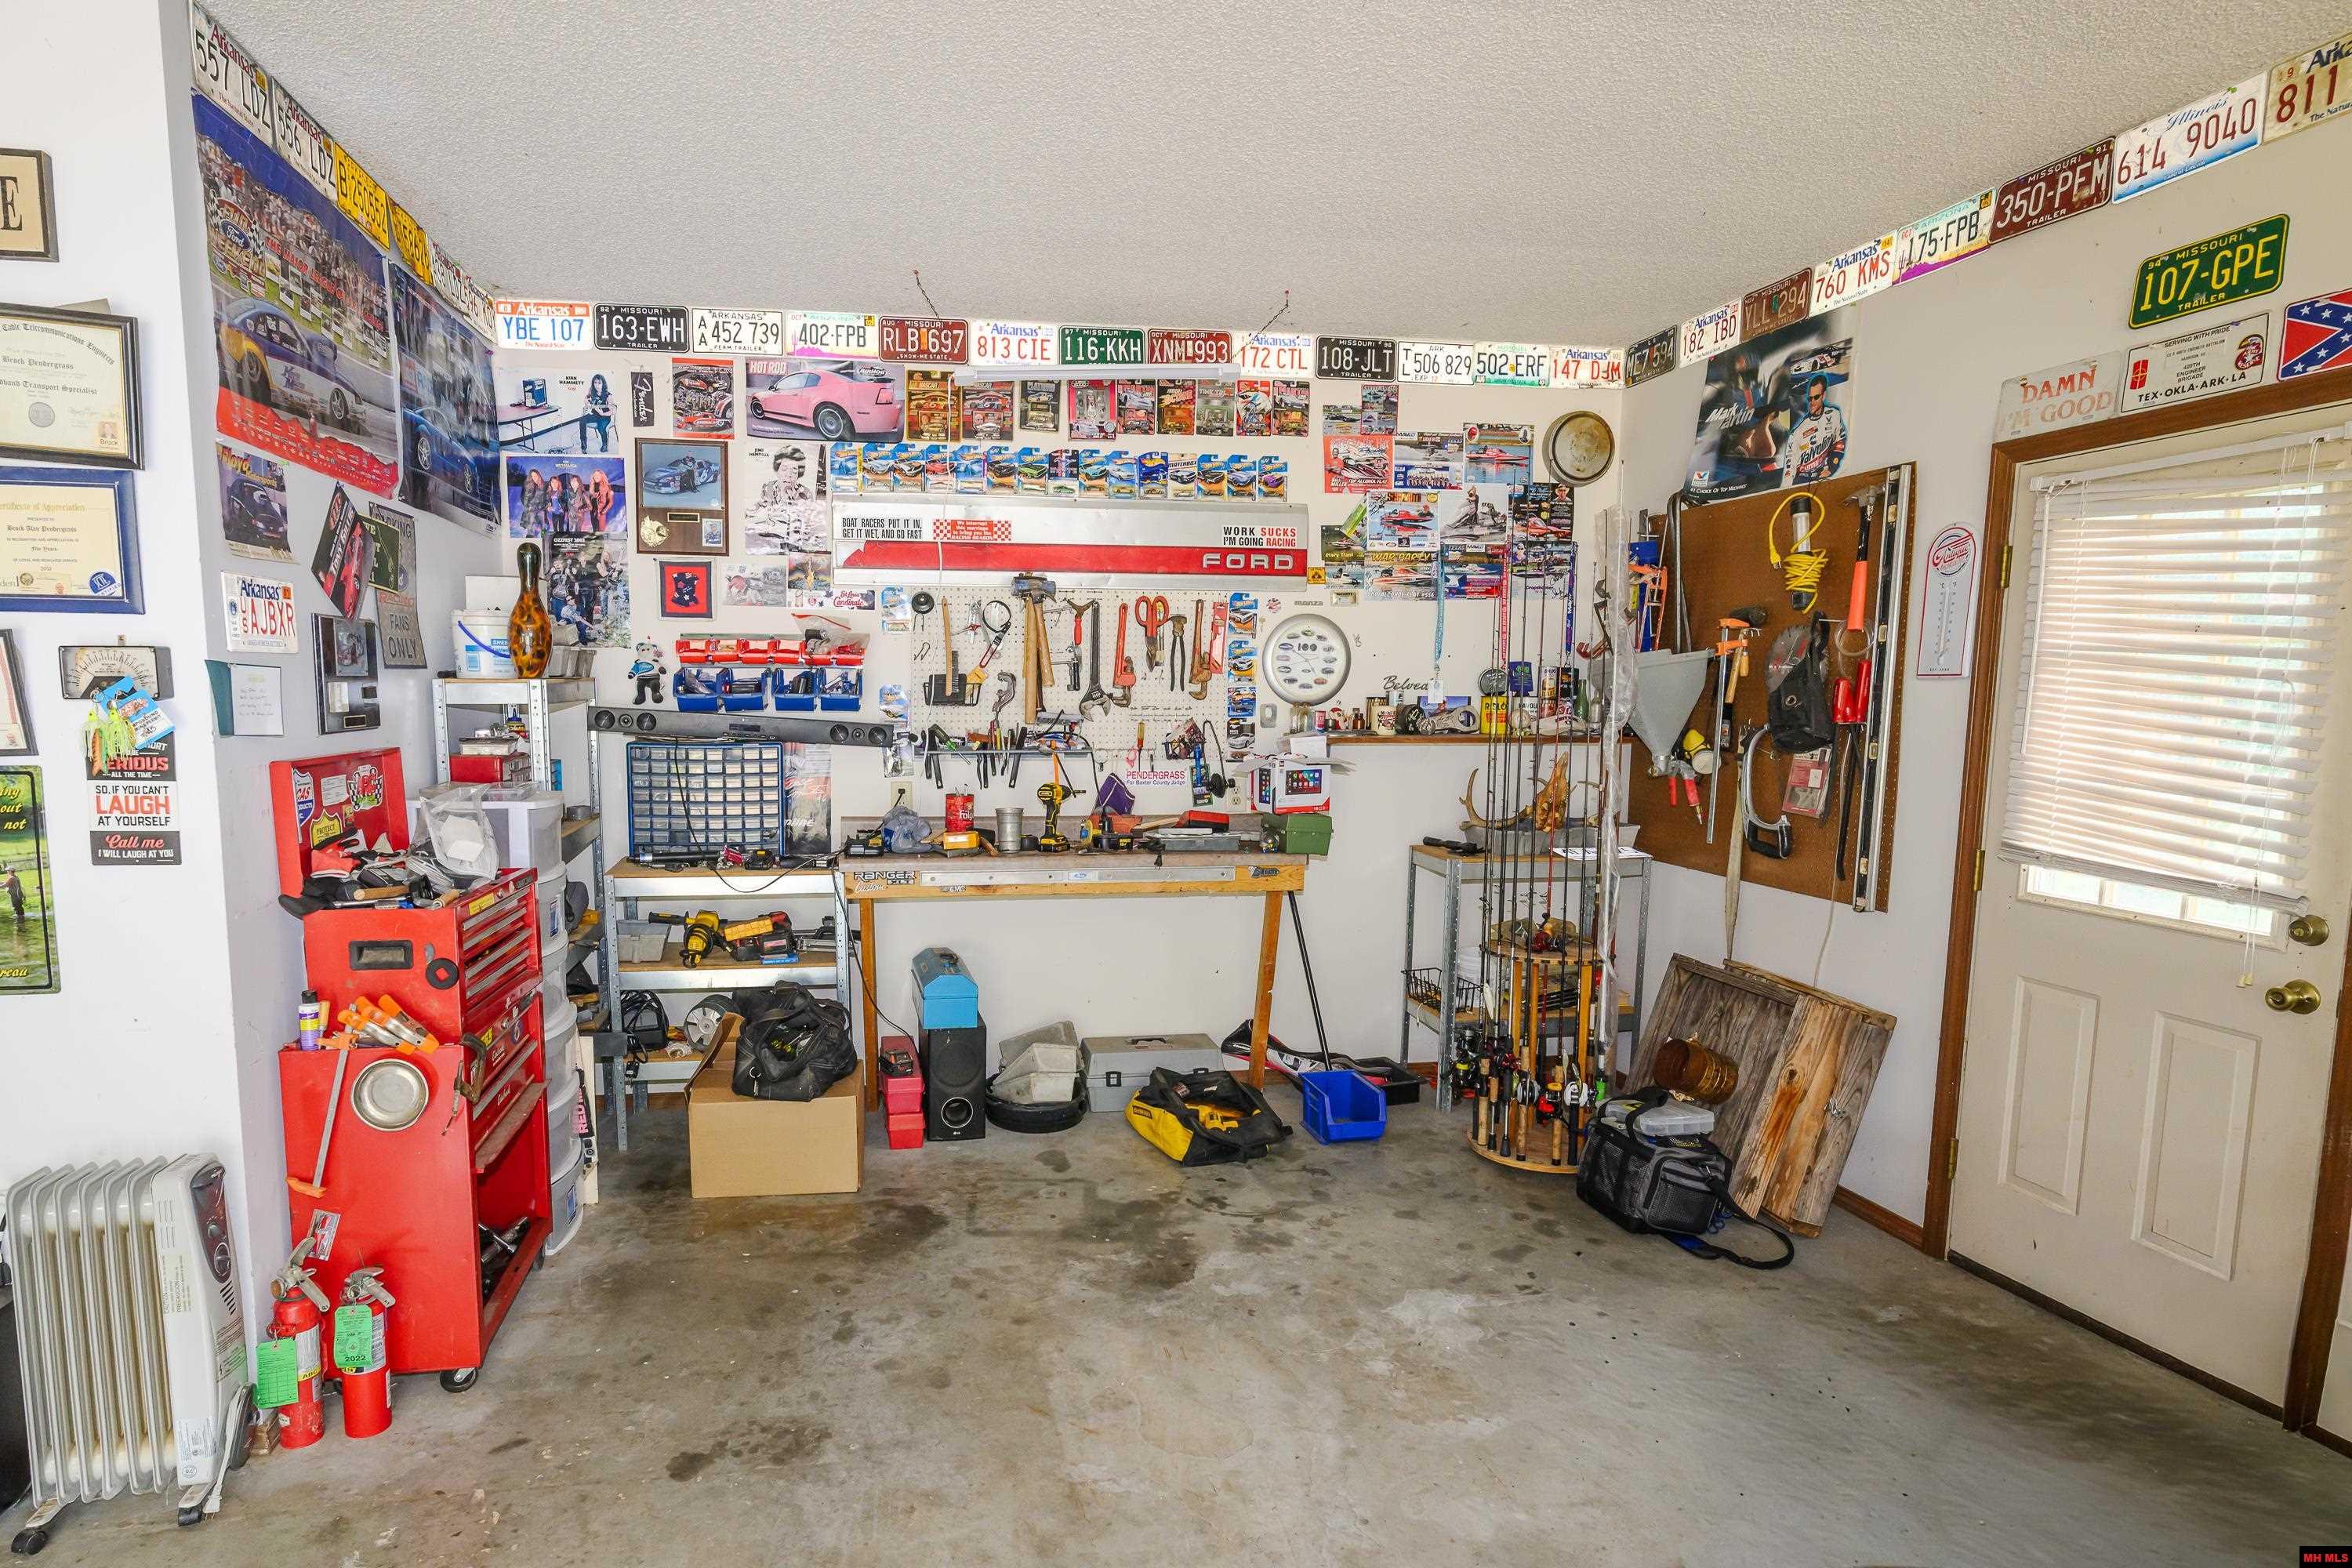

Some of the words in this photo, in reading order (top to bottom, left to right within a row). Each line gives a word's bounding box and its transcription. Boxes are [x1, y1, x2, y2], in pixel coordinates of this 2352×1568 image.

[211, 24, 254, 74] Arkansas
[195, 29, 230, 91] 557
[241, 68, 270, 129] LDZ
[2276, 64, 2339, 123] 811
[2166, 98, 2228, 132] Illinois
[2310, 112, 2325, 122] The
[278, 105, 302, 157] 556
[310, 136, 336, 189] LDZ
[2117, 136, 2167, 185] 614
[2186, 97, 2257, 158] 9040
[2027, 155, 2082, 184] MISSOURI
[2096, 143, 2107, 154] 91
[339, 161, 348, 198] B
[1995, 154, 2111, 229] 350-PEM
[2026, 208, 2068, 228] TRAILER
[226, 227, 245, 246] Ford
[2175, 232, 2244, 261] MISSOURI
[1831, 241, 1879, 273] Arkansas
[1815, 270, 1846, 303] 760
[1857, 250, 1891, 287] KMS
[2140, 233, 2280, 312] 107-GPE
[1761, 279, 1791, 298] MISSOURI
[1777, 281, 1809, 315] 294
[517, 302, 571, 315] Arkansas
[620, 307, 663, 315] MISSOURI
[2176, 292, 2227, 312] TRAILER
[711, 311, 764, 321] ARKANSAS
[905, 320, 944, 328] MISSOURI
[1693, 307, 1729, 330] Arkansas
[503, 317, 541, 341] YBE
[550, 318, 584, 341] 107
[600, 314, 684, 346] 163-EWH
[711, 321, 743, 344] 452
[750, 323, 780, 345] 739
[990, 321, 1039, 337] Arkansas
[1682, 326, 1704, 357] 182
[1714, 314, 1737, 344] IBD
[2164, 336, 2193, 348] SERVING
[2193, 331, 2211, 342] WITH
[2211, 325, 2231, 336] PRIDE
[883, 326, 920, 352] RLB
[927, 330, 964, 354] 697
[977, 335, 1011, 358] 813
[1017, 337, 1052, 361] CIE
[1065, 336, 1142, 363] 116-KKH
[1253, 334, 1298, 347] Arkansas
[1338, 339, 1377, 347] MISSOURI
[1152, 337, 1186, 364] XNM
[1194, 338, 1229, 364] 993
[1240, 345, 1272, 370] 172
[1278, 347, 1308, 371] CTL
[1321, 345, 1393, 372] 108-JLT
[1566, 348, 1608, 361] Arkansas
[1653, 337, 1675, 368] 594
[750, 361, 768, 375] HOT
[769, 362, 788, 376] ROD
[1414, 353, 1439, 376] 506
[1445, 354, 1472, 377] 829
[1476, 352, 1508, 376] 502
[1515, 355, 1547, 377] ERF
[1552, 359, 1581, 379] 147
[2176, 365, 2207, 378] ENGINEER
[2183, 361, 2201, 370] 420TH
[2022, 365, 2096, 405] DAMN
[2177, 372, 2204, 383] BRIGADE
[1706, 402, 1738, 423] Mark
[2040, 390, 2116, 424] GOOD
[1167, 460, 1197, 469] MATCHBOX
[842, 517, 858, 528] BOAT
[861, 517, 886, 529] RACERS
[887, 518, 902, 528] PUT
[903, 519, 910, 528] IT
[1223, 526, 1256, 536] WORK
[1260, 527, 1297, 537] SUCKS
[842, 528, 856, 539] GET
[857, 529, 864, 539] IT
[881, 529, 895, 539] AND
[896, 529, 906, 539] GO
[906, 529, 923, 539] FAST
[1223, 536, 1236, 546] I'M
[1238, 536, 1264, 546] GOING
[1265, 536, 1296, 547] RACING
[1202, 552, 1294, 571] FORD
[1371, 552, 1396, 562] WAR
[1399, 552, 1432, 562] PARTY
[241, 579, 280, 601] Arkansas
[833, 597, 864, 608] Cardinals
[250, 598, 296, 637] AJBXR
[389, 613, 410, 632] FANS
[388, 636, 417, 659] ONLY
[1126, 770, 1185, 779] PENDERGRASS
[142, 786, 169, 795] CAN'T
[297, 786, 311, 800] GAS
[96, 795, 171, 815] LAUGH
[4, 818, 27, 830] not
[97, 816, 112, 826] AT
[115, 816, 171, 826] YOURSELF
[105, 834, 140, 849] Call
[141, 837, 165, 849] me
[122, 850, 147, 858] LAUGH
[147, 850, 158, 858] AT
[159, 849, 174, 858] YOU
[854, 871, 916, 882] RANGER
[855, 879, 885, 894] Custom
[344, 1354, 367, 1363] 2022
